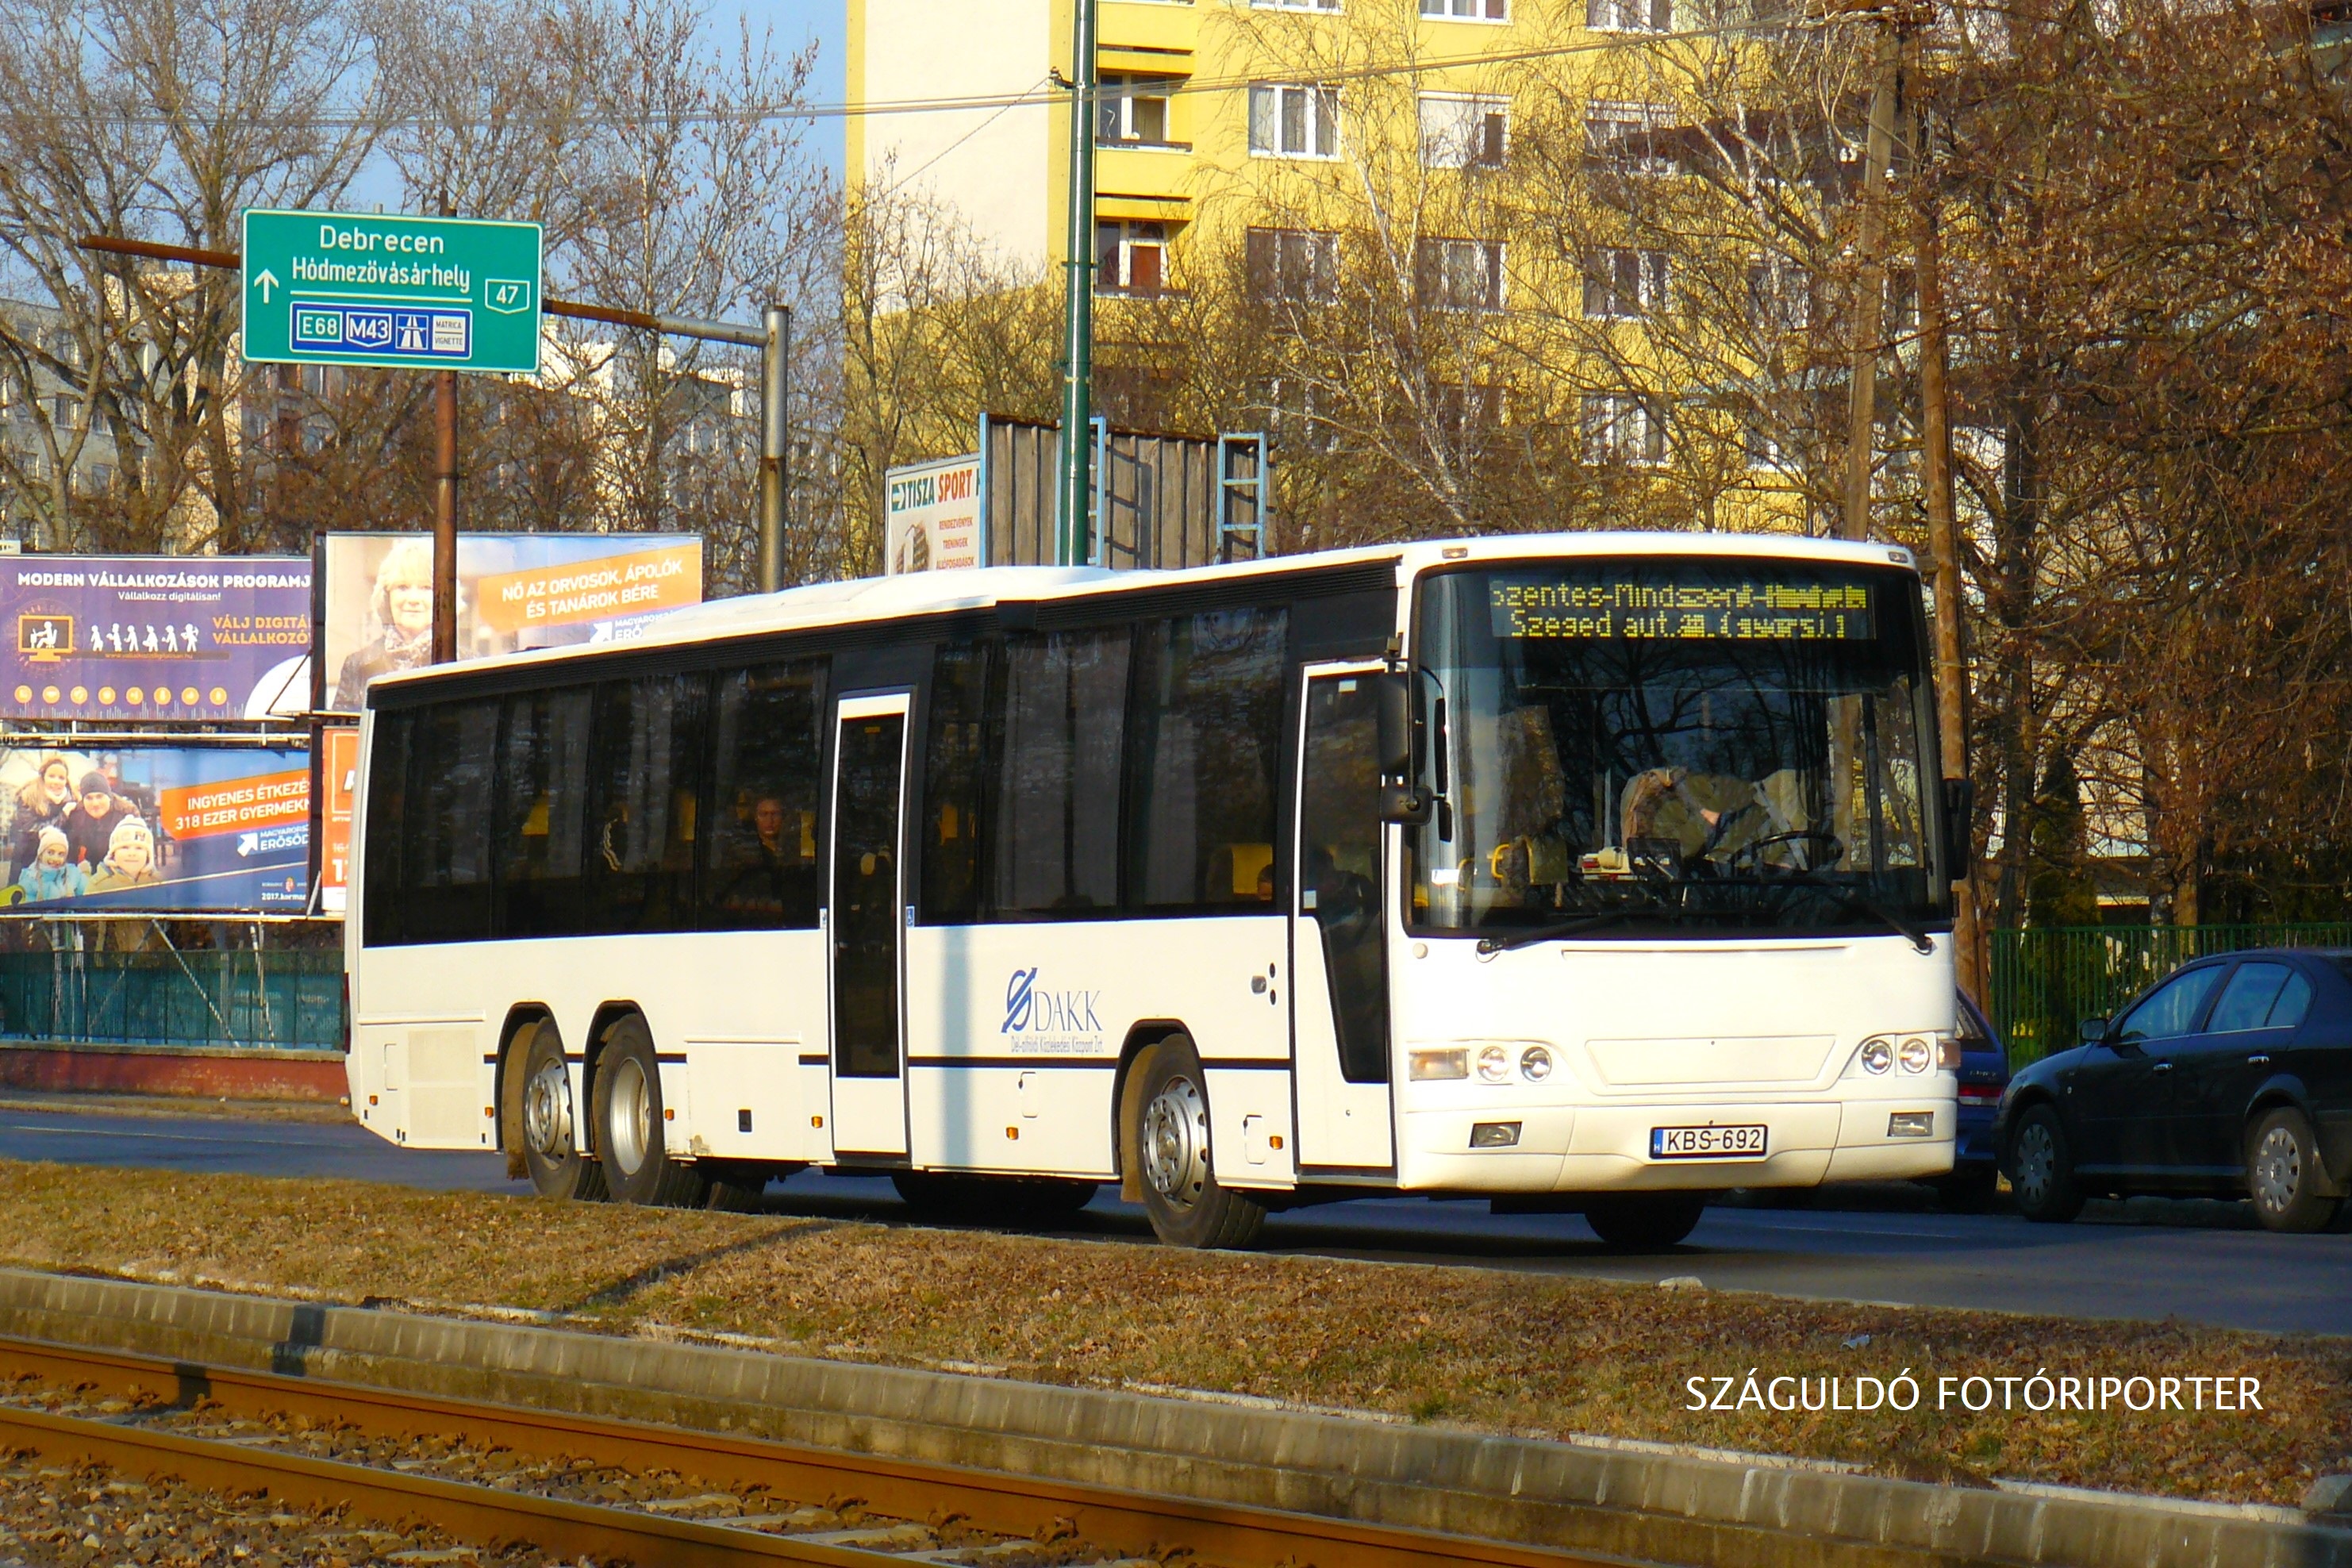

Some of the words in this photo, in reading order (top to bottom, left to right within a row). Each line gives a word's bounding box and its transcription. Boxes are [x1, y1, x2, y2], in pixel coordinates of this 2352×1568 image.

[320, 225, 444, 253] Debrecen
[496, 286, 519, 304] 47
[349, 318, 389, 340] M43
[436, 321, 462, 330] MATRICA
[435, 336, 463, 346] VIGNETTE
[907, 476, 935, 509] TISZA
[938, 469, 973, 503] SPORT
[17, 572, 85, 588] MODERN
[88, 570, 219, 589] VÁLLALKOZÁSOK
[502, 582, 524, 601] NŐ
[526, 580, 546, 597] AZ
[549, 571, 622, 594] ORVOSOK,
[625, 559, 682, 581] ÁPOLÓK
[118, 591, 167, 601] Vállalkozz
[169, 591, 221, 603] digitálisan!
[526, 601, 545, 619] ÉS
[549, 593, 617, 614] TANÁROK
[621, 583, 658, 604] BÉRE
[213, 613, 250, 629] VÁLJ
[255, 614, 311, 629] DIGITÁ
[1511, 609, 1612, 637] Szeged
[213, 629, 311, 645] VÁLLALKOZÓ
[188, 789, 254, 810] INGYENES
[259, 778, 310, 799] ÉTKEZÉ
[175, 815, 199, 831] 318
[202, 809, 237, 827] EZER
[1035, 991, 1102, 1032] DAKK
[1667, 1129, 1761, 1151] KBS-692
